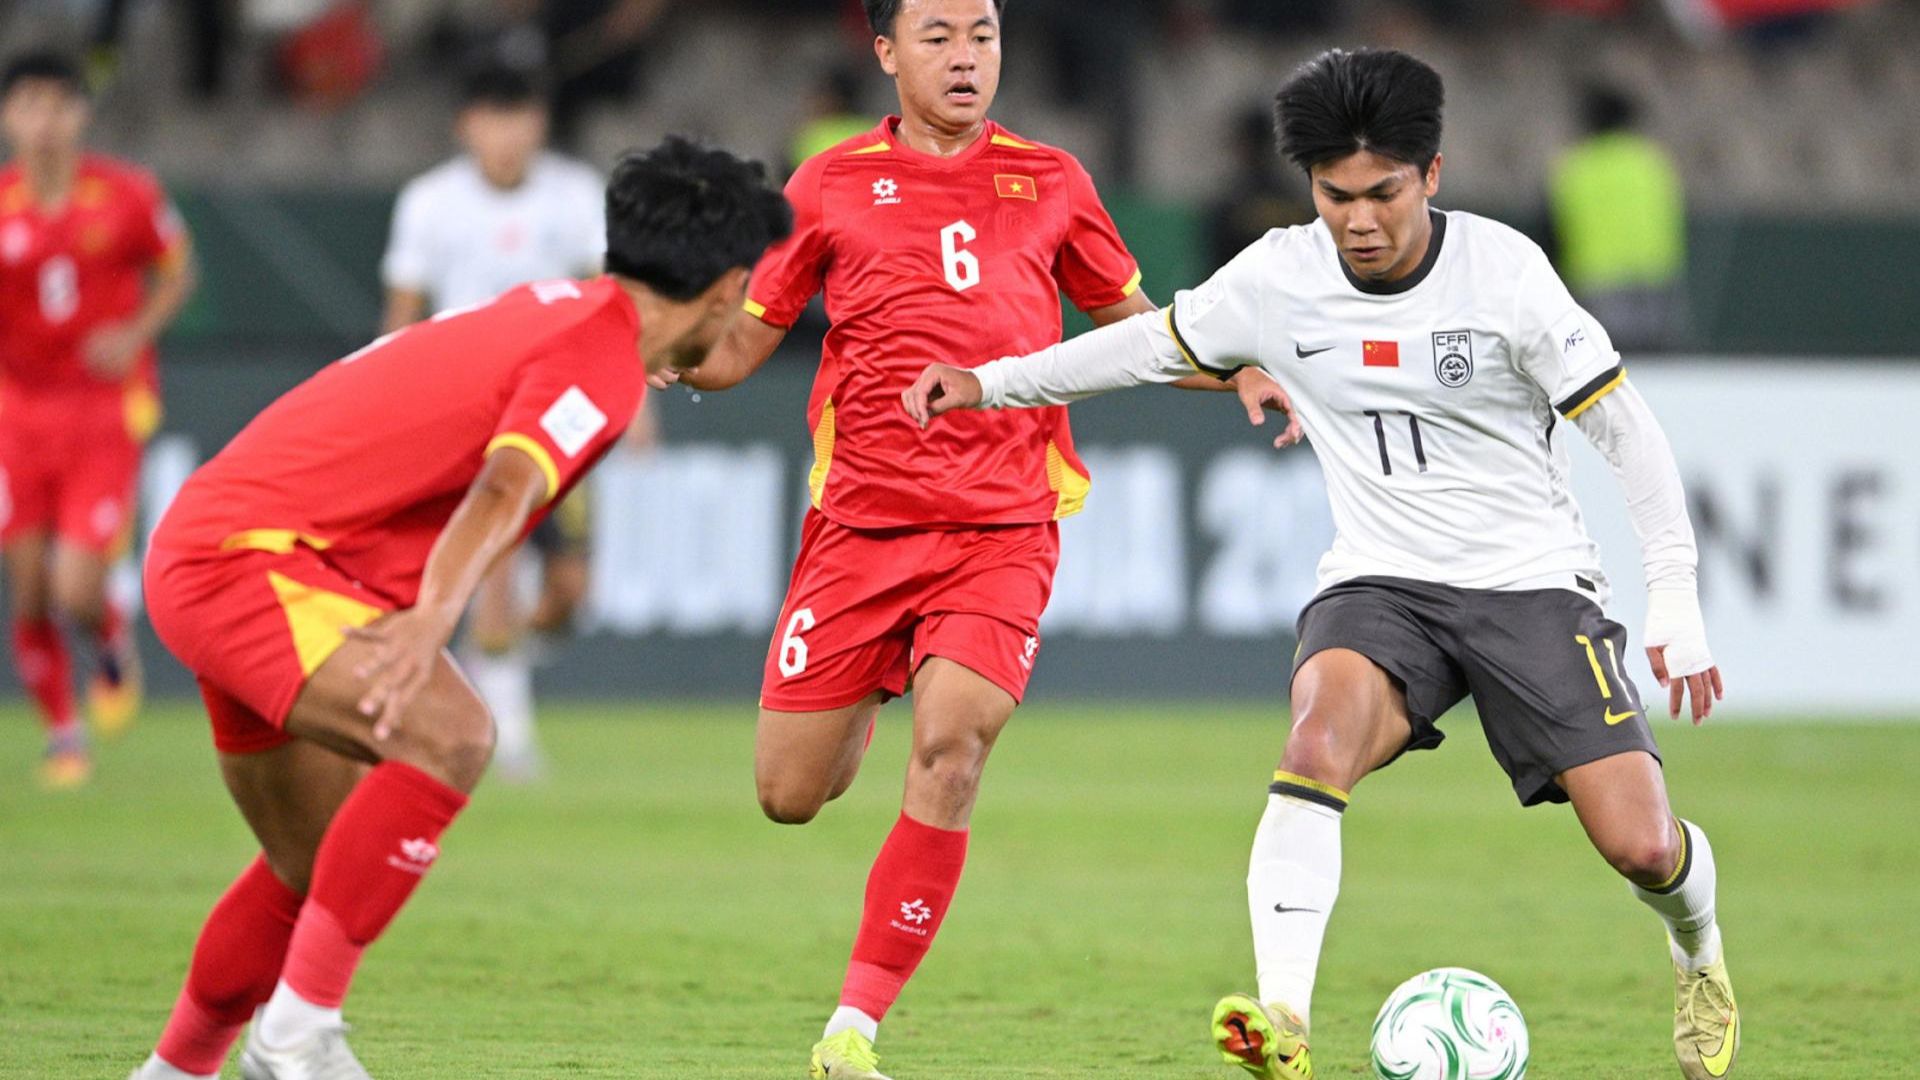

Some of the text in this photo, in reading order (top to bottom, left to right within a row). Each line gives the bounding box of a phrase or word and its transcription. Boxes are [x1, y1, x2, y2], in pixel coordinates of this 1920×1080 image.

[940, 219, 980, 292] 6
[1436, 334, 1467, 346] CFA
[1363, 410, 1427, 476] 11
[778, 608, 816, 678] 6
[1575, 634, 1632, 704] 11
